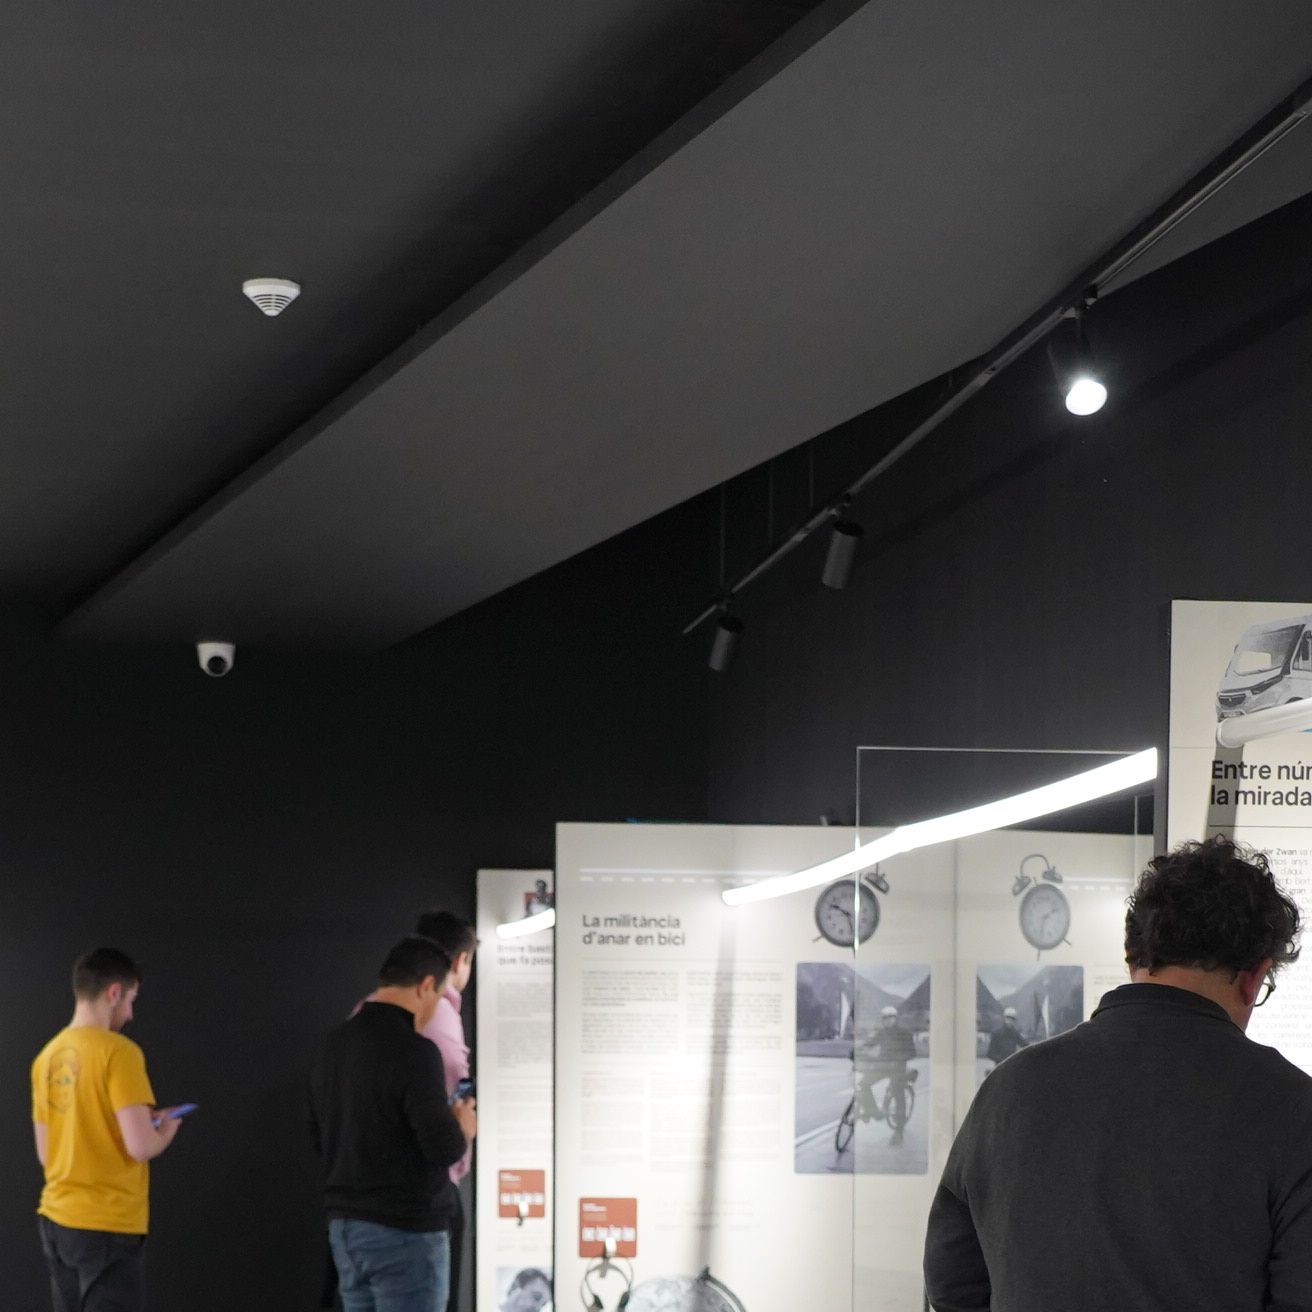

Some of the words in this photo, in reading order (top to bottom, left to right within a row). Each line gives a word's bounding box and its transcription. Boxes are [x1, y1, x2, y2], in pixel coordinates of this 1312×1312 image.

[1211, 760, 1272, 780] Entre
[1210, 785, 1229, 805] la
[1235, 786, 1312, 807] mirada
[582, 914, 600, 928] La
[603, 914, 681, 929] militància
[635, 934, 654, 945] en
[658, 932, 686, 946] bici
